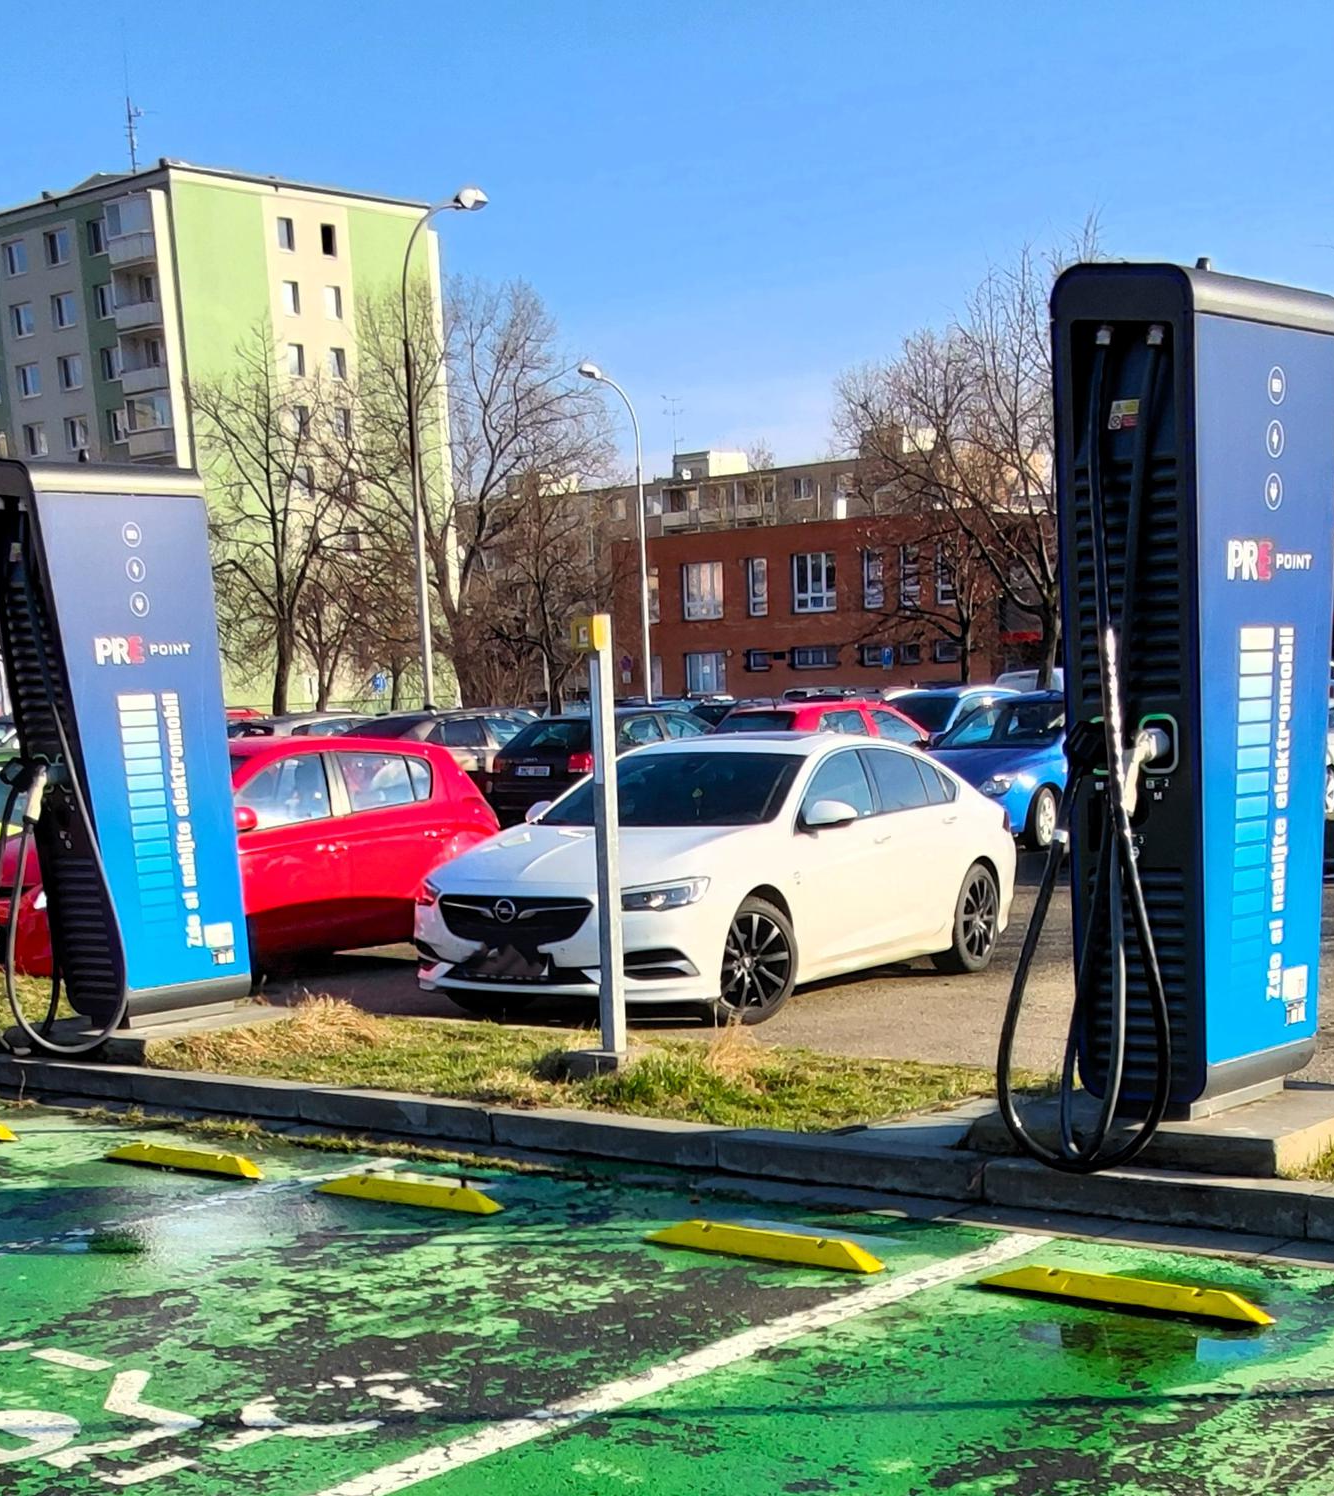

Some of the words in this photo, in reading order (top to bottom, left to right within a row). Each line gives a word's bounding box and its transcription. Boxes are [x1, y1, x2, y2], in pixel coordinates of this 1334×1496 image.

[1227, 540, 1272, 581] PRE
[1276, 553, 1312, 571] POINT
[94, 635, 146, 665] PRE
[149, 643, 191, 656] POINT
[1274, 627, 1294, 809] elektromobil
[161, 692, 190, 817] elektromobil
[1269, 918, 1284, 945] si
[1266, 952, 1282, 1001] Zde
